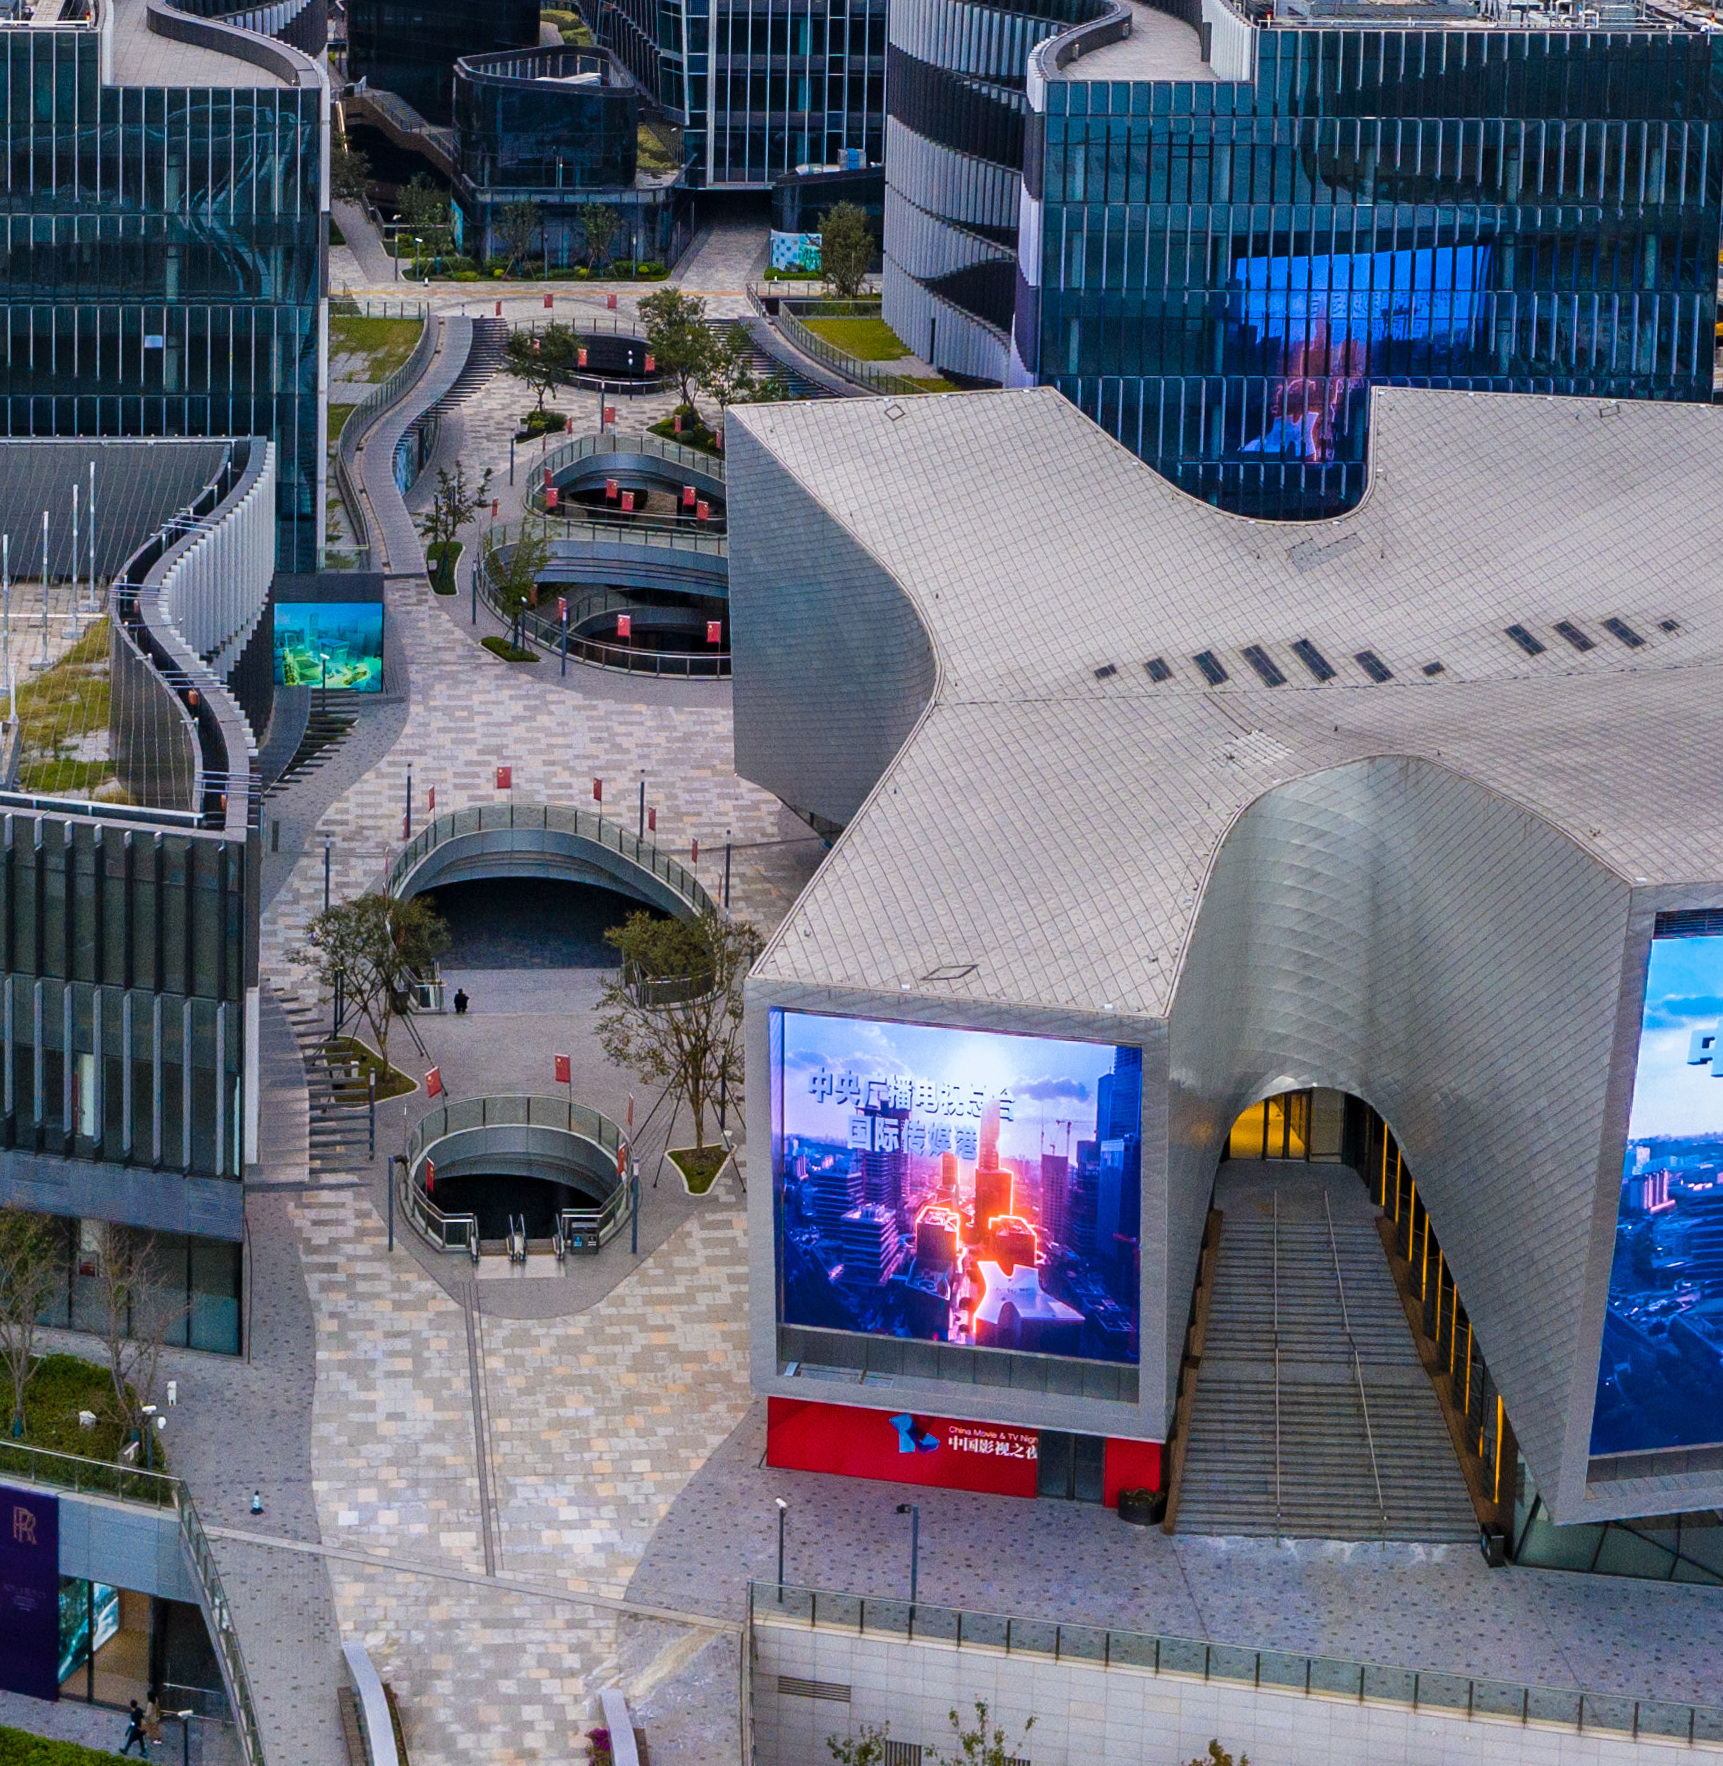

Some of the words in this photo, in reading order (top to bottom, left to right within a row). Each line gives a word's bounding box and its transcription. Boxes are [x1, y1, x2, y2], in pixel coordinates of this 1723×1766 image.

[847, 1115, 978, 1160] 国际传媒港
[948, 1425, 972, 1436] China
[973, 1429, 997, 1439] Movie
[1007, 1433, 1019, 1441] TV
[1020, 1435, 1038, 1444] Nigh
[948, 1435, 1038, 1460] 中国影视之夜
